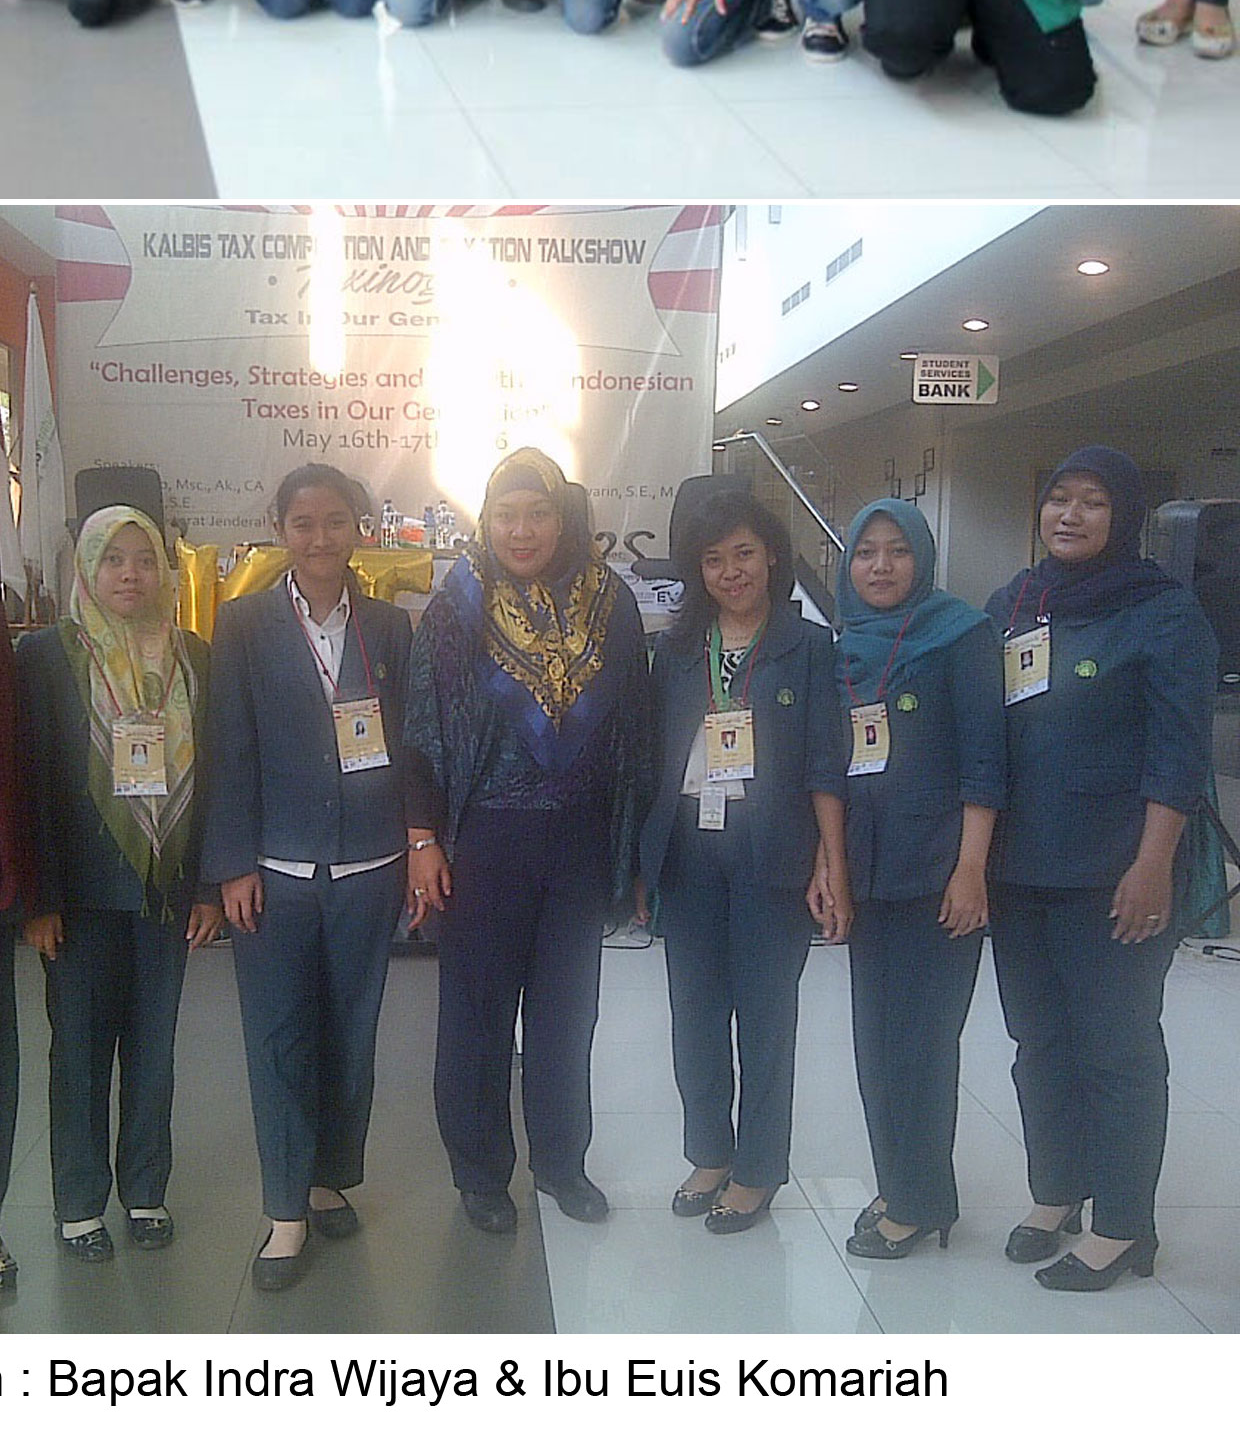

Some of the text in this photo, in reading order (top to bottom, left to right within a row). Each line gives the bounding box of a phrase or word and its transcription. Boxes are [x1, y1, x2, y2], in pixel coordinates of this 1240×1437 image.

[143, 232, 212, 260] KALBIS
[217, 233, 256, 260] TAX
[390, 235, 431, 262] AND
[537, 237, 647, 265] TALKSHOW
[244, 309, 289, 326] Tax
[921, 359, 970, 369] STUDENT
[374, 366, 424, 389] and
[920, 369, 971, 378] SERVICES
[918, 383, 971, 398] BANK
[241, 397, 310, 421] Taxes
[316, 399, 339, 421] in
[346, 399, 396, 422] Our
[282, 427, 332, 455] May
[244, 479, 265, 493] CA
